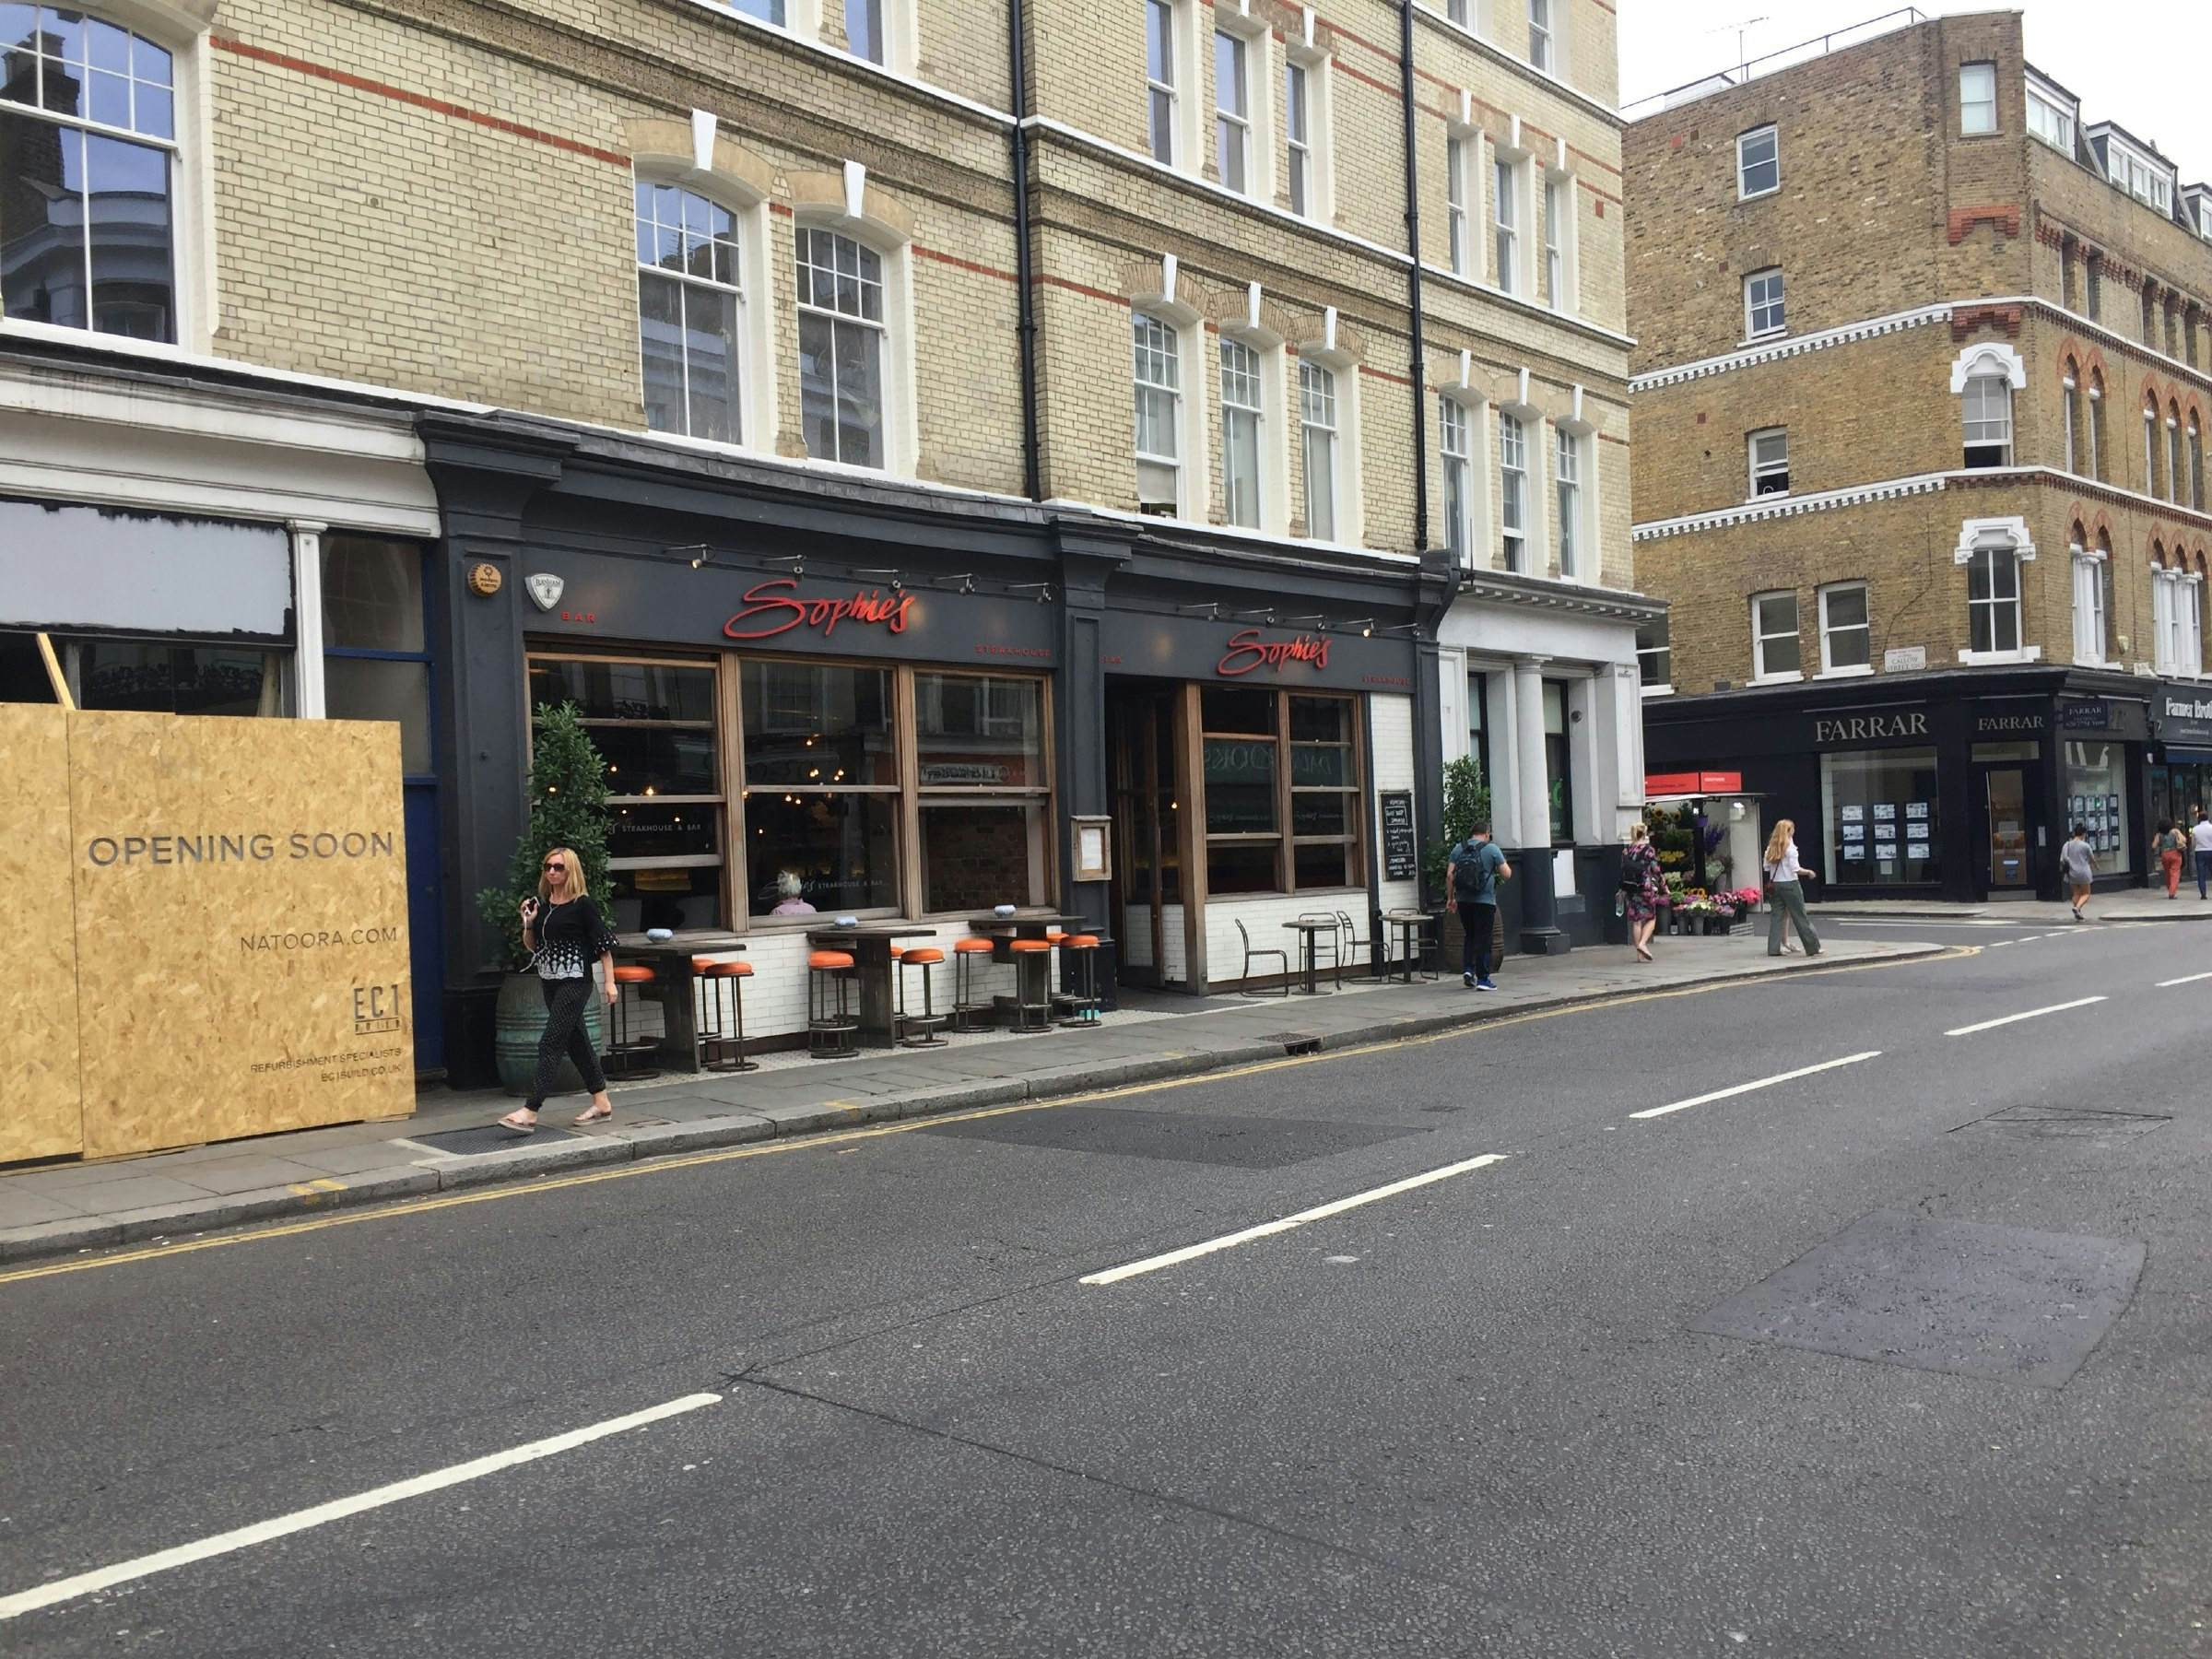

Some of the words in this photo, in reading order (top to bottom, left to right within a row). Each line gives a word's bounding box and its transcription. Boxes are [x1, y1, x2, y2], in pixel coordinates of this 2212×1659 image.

[561, 611, 596, 623] BAR
[724, 580, 916, 638] Sophie's
[974, 645, 1053, 657] STEAKHOUSE
[1217, 629, 1334, 675] Sophie's
[2068, 707, 2102, 716] FARRAR
[2166, 697, 2193, 718] Farmer
[1815, 713, 1929, 743] FARRAR
[1978, 715, 2044, 730] FARRAR
[88, 834, 274, 866] OPENING
[288, 831, 393, 859] SOON
[240, 927, 397, 952] NATOORA.COM
[250, 1056, 337, 1074] REFURBISHMENT
[339, 1047, 402, 1062] SPECIALISTS
